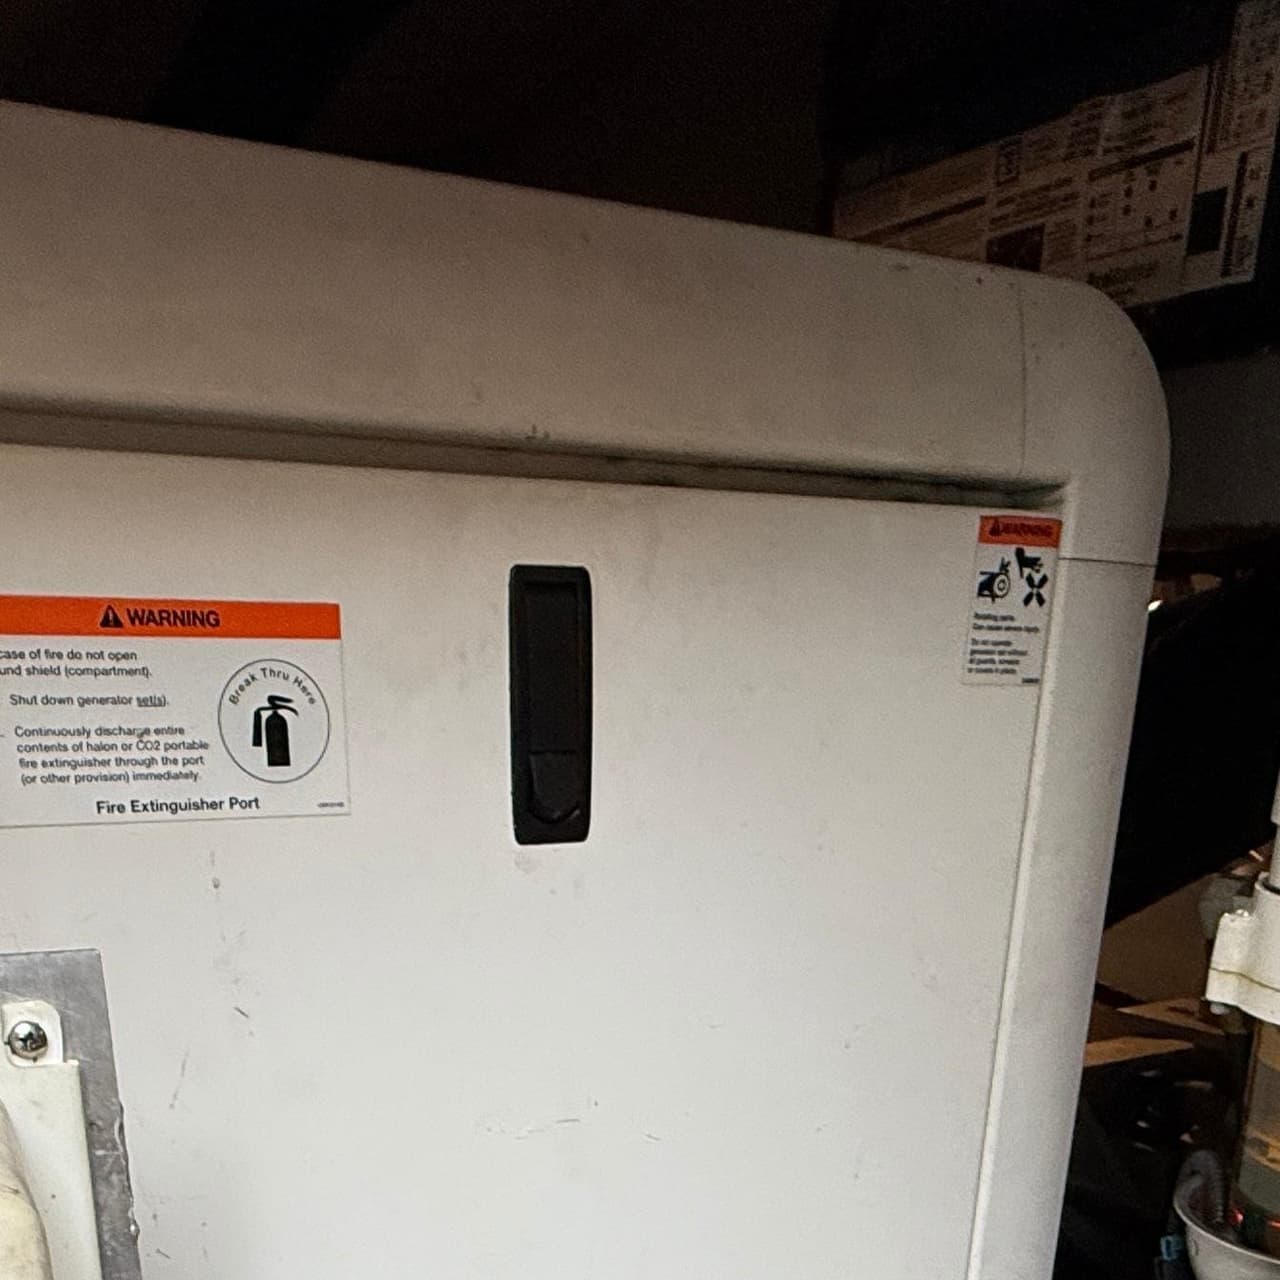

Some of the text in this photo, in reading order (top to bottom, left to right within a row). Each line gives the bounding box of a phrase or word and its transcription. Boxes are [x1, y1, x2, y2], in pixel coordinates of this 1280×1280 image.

[126, 608, 220, 628] WARNING
[29, 648, 42, 661] of
[44, 648, 64, 661] fire
[67, 648, 83, 661] do
[86, 649, 105, 661] not
[108, 651, 138, 663] open
[25, 665, 61, 677] shield
[64, 665, 153, 680] (compartment).
[228, 667, 317, 706] Break Thru Here
[9, 694, 40, 706] Shut
[43, 694, 75, 706] down
[77, 695, 133, 708] generator
[14, 725, 91, 740] Continuously
[94, 726, 151, 740] discharge
[154, 726, 185, 737] entire
[16, 740, 210, 753] contents of halon or CO2 portable
[19, 754, 206, 771] fire extinguisher through the port
[21, 773, 37, 787] (or
[40, 772, 71, 785] other
[73, 771, 130, 786] provision)
[96, 796, 261, 815] Fire Extinguisher Port
